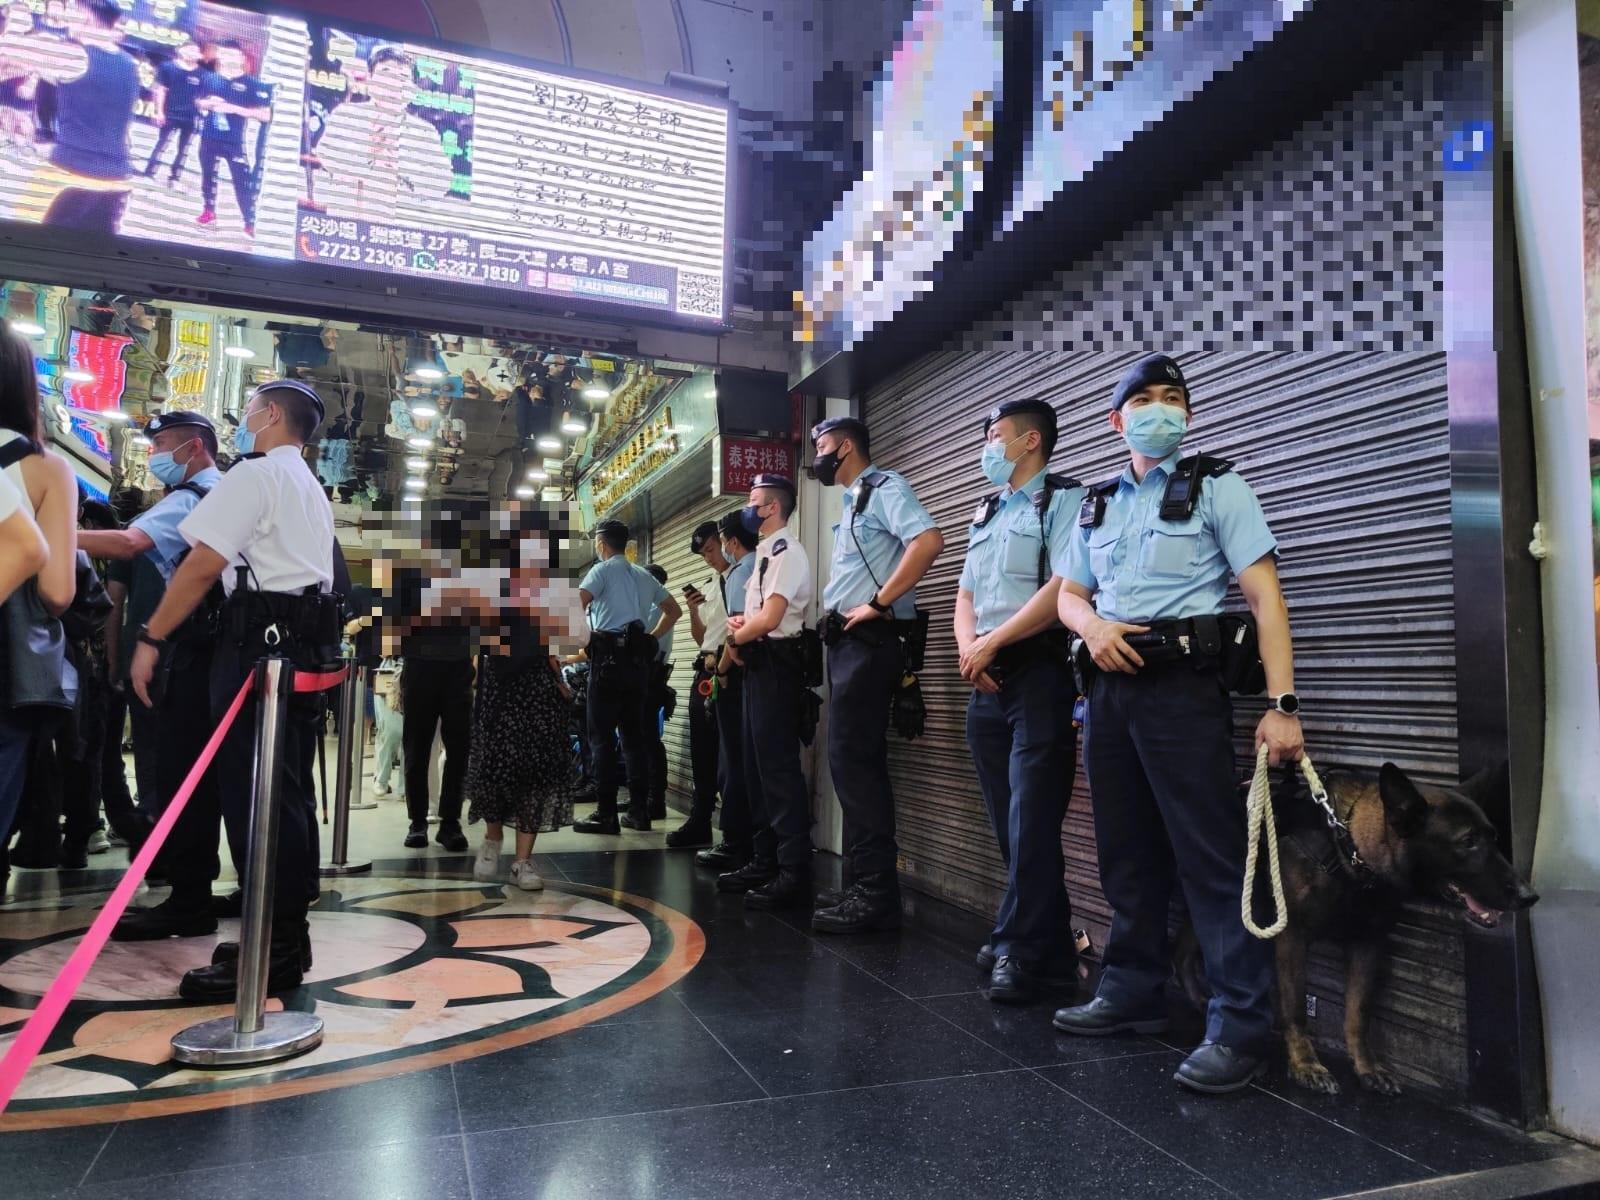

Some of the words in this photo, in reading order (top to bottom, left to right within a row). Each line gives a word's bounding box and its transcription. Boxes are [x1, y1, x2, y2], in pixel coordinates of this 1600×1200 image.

[318, 240, 361, 261] 2723
[364, 247, 406, 268] 2306
[728, 445, 789, 471] 泰安找換
